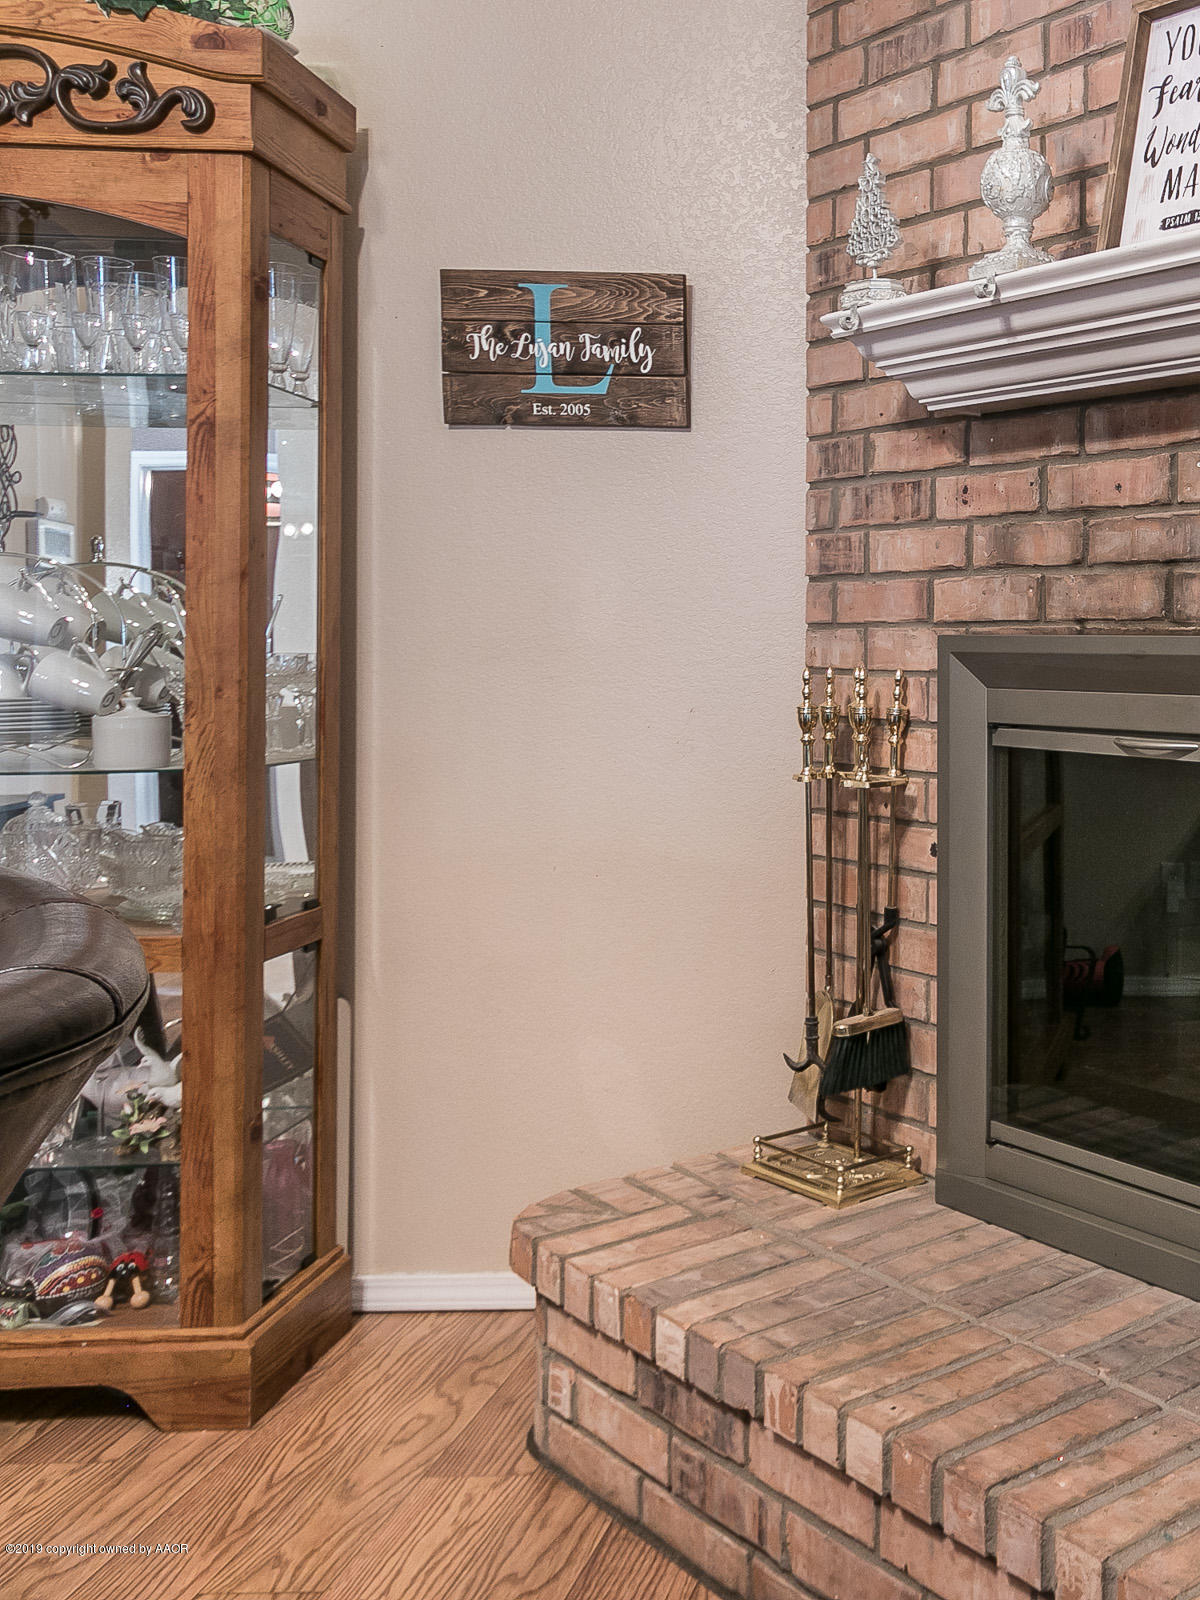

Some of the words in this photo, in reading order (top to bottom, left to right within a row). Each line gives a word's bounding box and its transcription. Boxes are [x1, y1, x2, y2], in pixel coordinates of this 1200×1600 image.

[1165, 213, 1191, 228] PSALM
[466, 324, 508, 361] The
[511, 332, 575, 368] Lujan
[578, 327, 656, 374] Family
[518, 283, 615, 395] L
[532, 403, 557, 416] Est.
[560, 403, 591, 416] 2005
